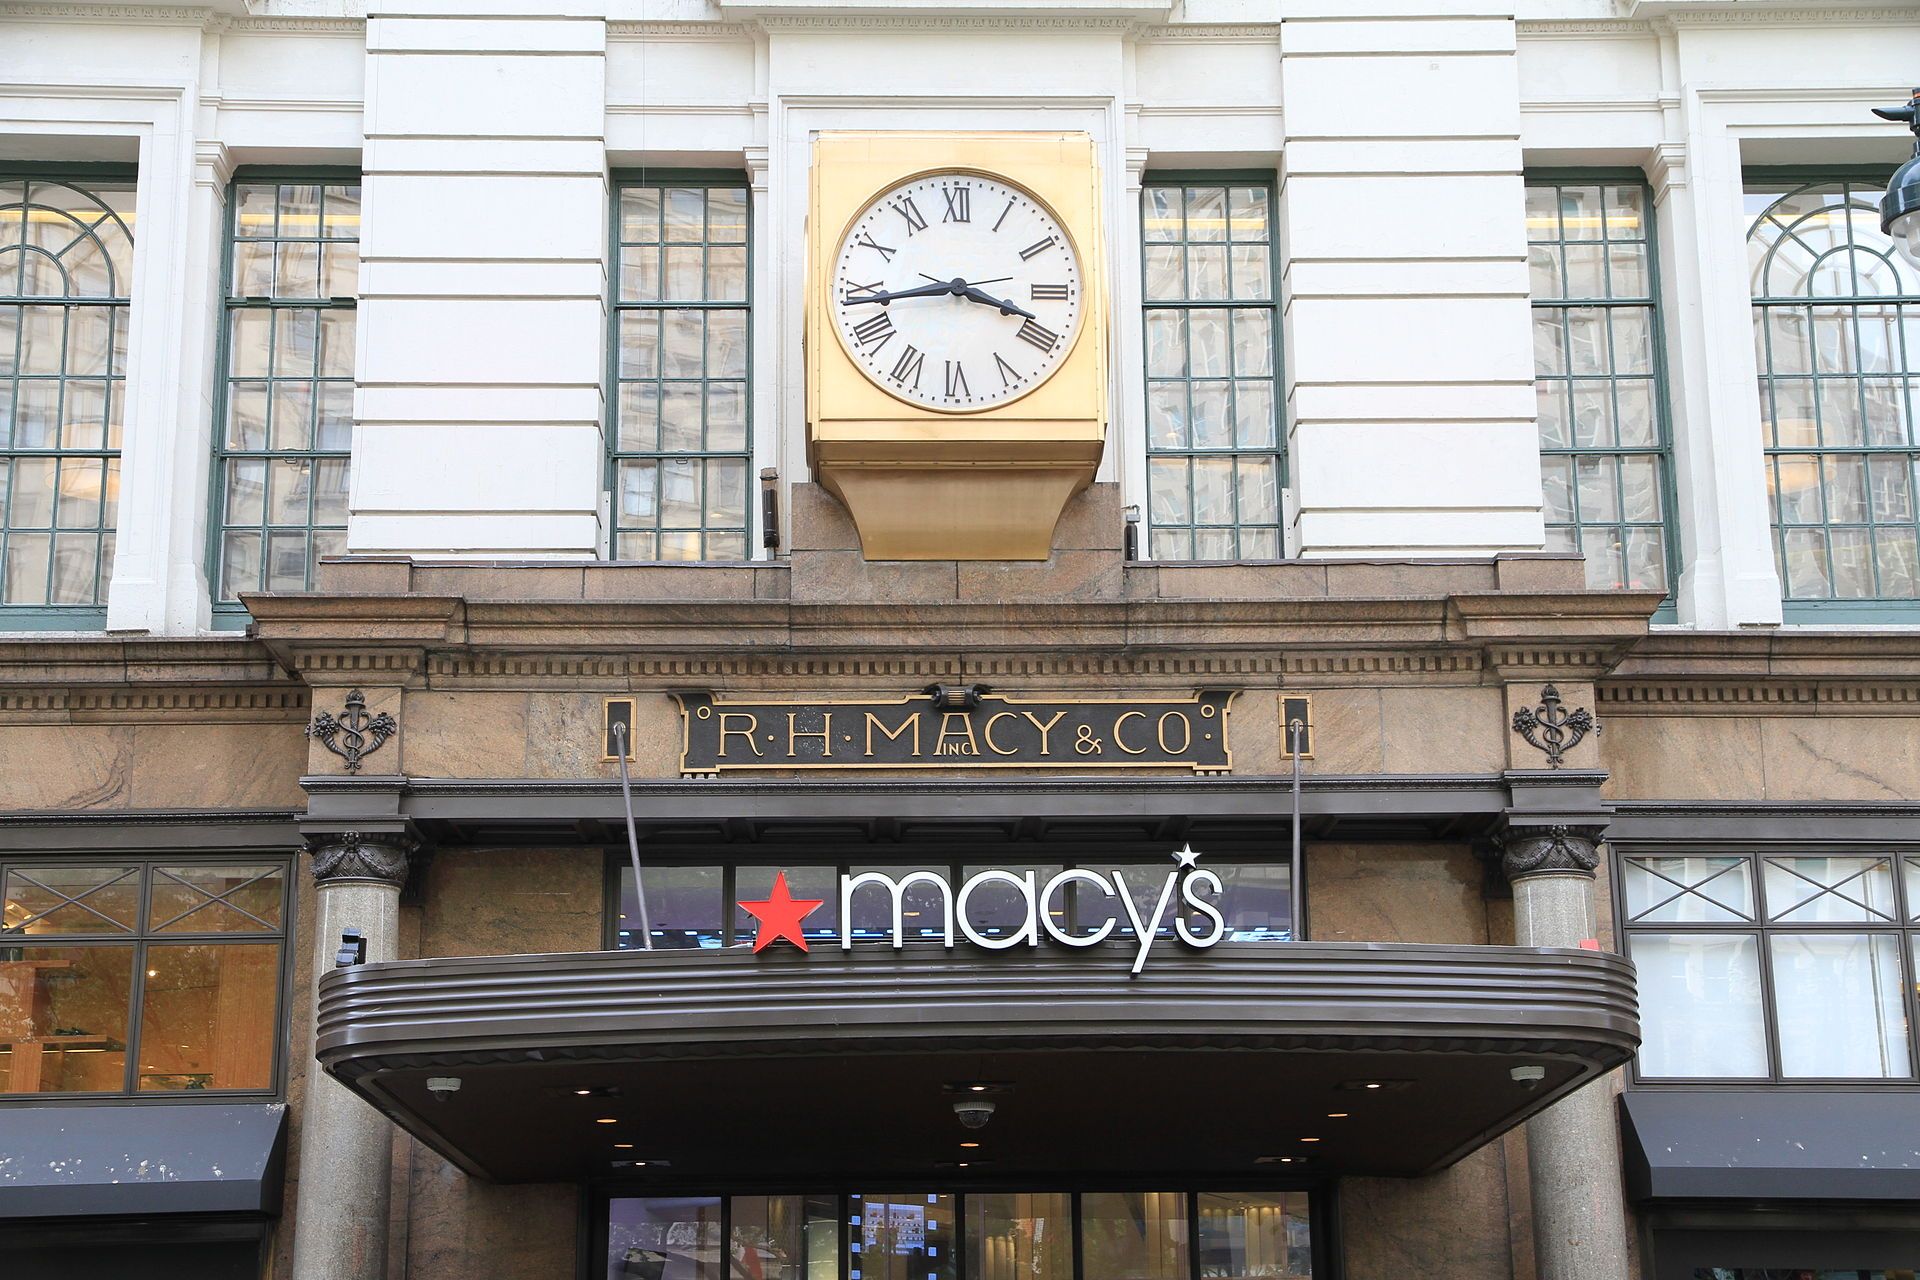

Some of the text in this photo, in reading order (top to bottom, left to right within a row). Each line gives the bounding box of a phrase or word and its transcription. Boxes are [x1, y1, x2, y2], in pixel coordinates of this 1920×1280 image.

[892, 197, 928, 237] XI
[942, 187, 970, 223] XII
[992, 200, 1014, 232] I
[858, 232, 896, 263] X
[1019, 236, 1055, 261] II
[1031, 284, 1068, 301] III
[853, 311, 897, 357] VIII
[1016, 317, 1059, 353] IIII
[890, 344, 925, 389] VII
[945, 360, 970, 397] VI
[993, 352, 1022, 387] V
[942, 742, 971, 756] INC
[1075, 724, 1102, 756] &
